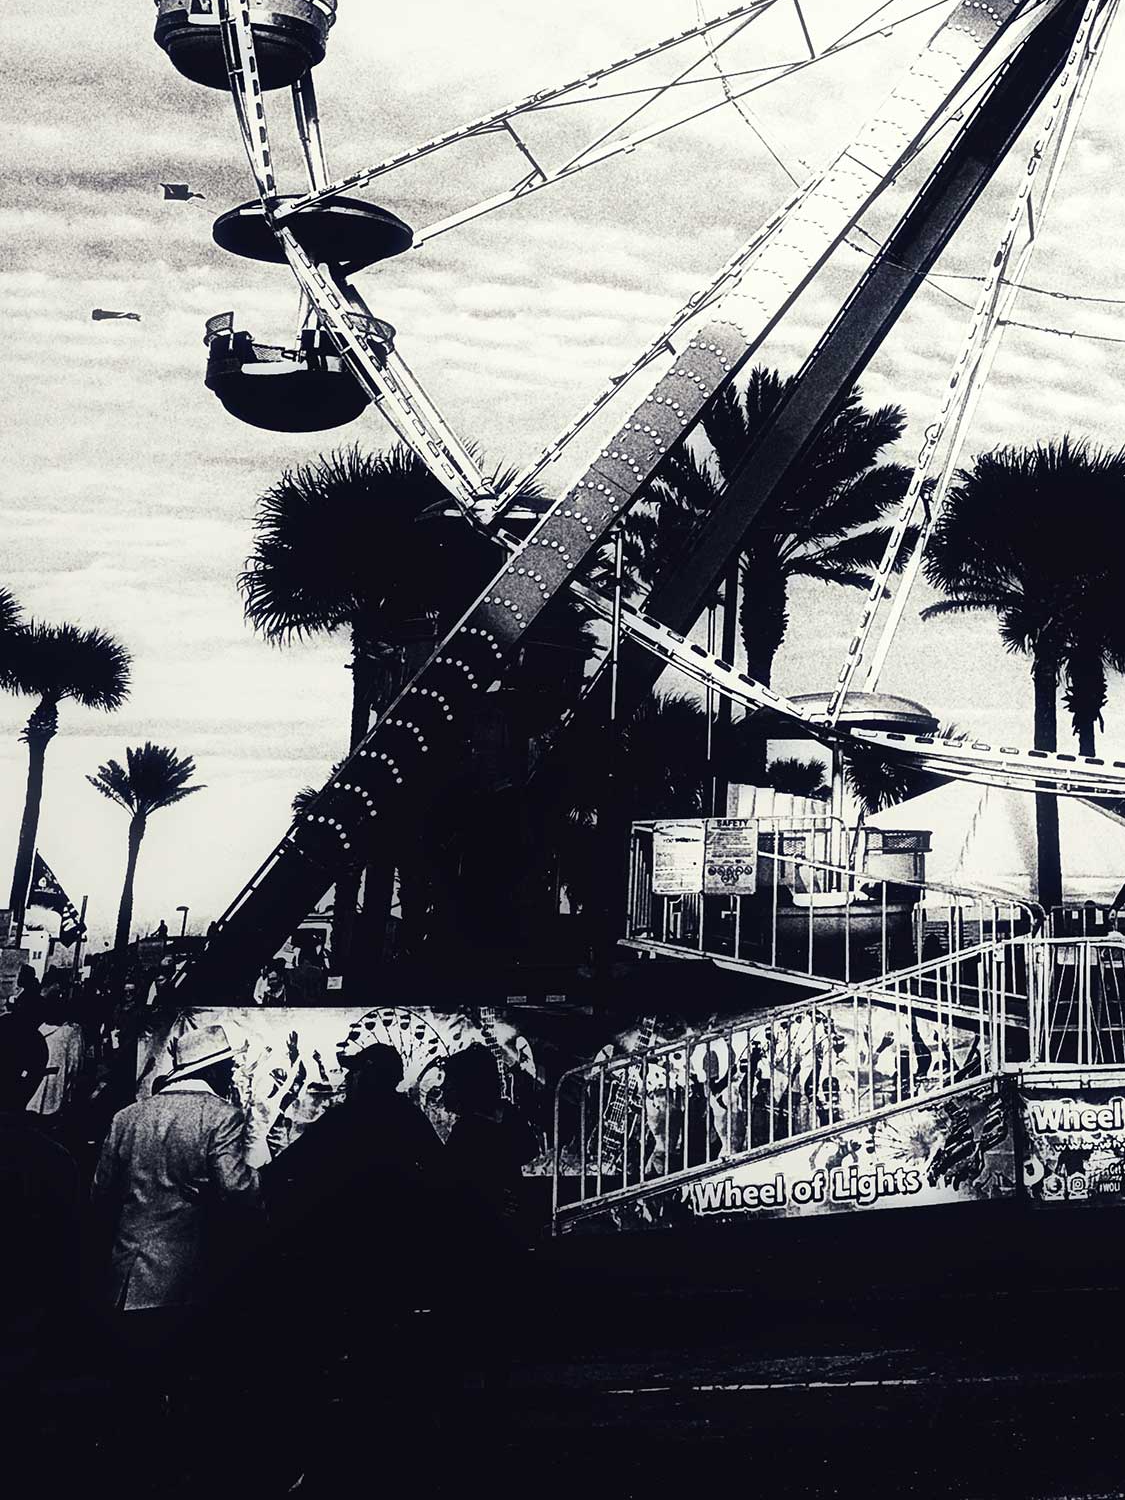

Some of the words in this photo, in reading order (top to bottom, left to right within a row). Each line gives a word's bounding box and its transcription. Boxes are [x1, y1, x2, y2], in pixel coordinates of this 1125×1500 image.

[1033, 1099, 1122, 1131] Wheel
[695, 1173, 784, 1209] Wheel
[793, 1171, 824, 1201] of
[834, 1165, 919, 1203] Lights
